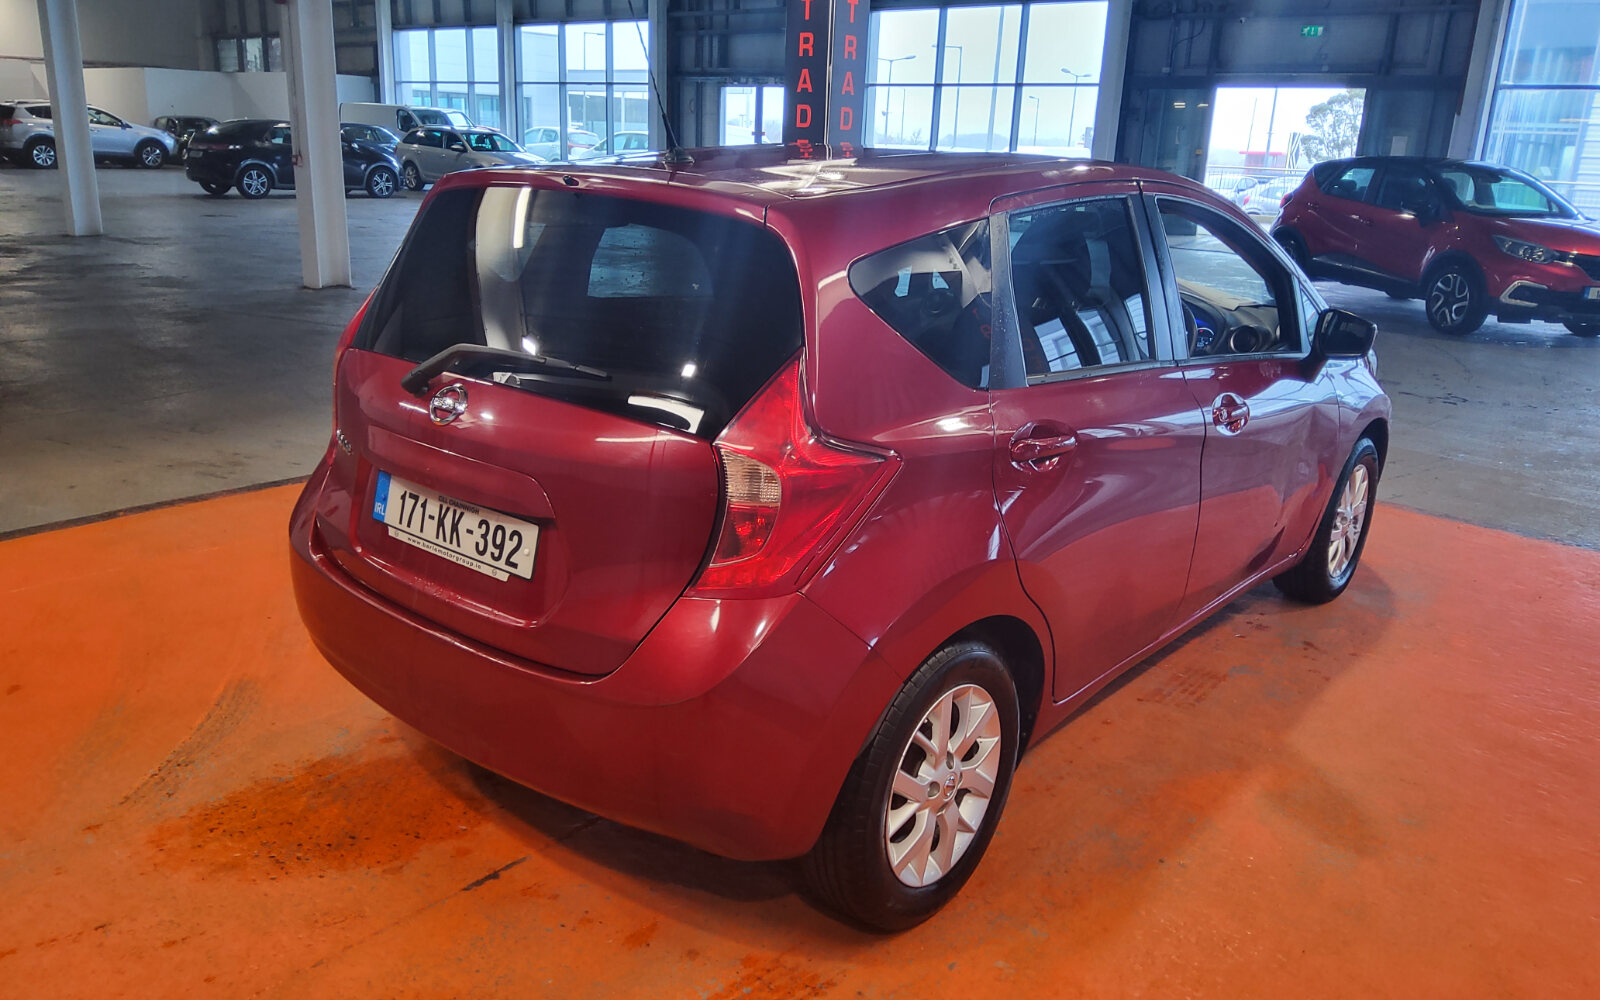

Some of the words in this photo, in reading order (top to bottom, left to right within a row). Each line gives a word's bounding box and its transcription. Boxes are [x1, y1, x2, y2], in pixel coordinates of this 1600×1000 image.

[796, 0, 815, 145] TRAD
[839, 0, 859, 147] TRAD
[374, 502, 385, 516] IRL
[398, 490, 523, 570] 171-KK-392
